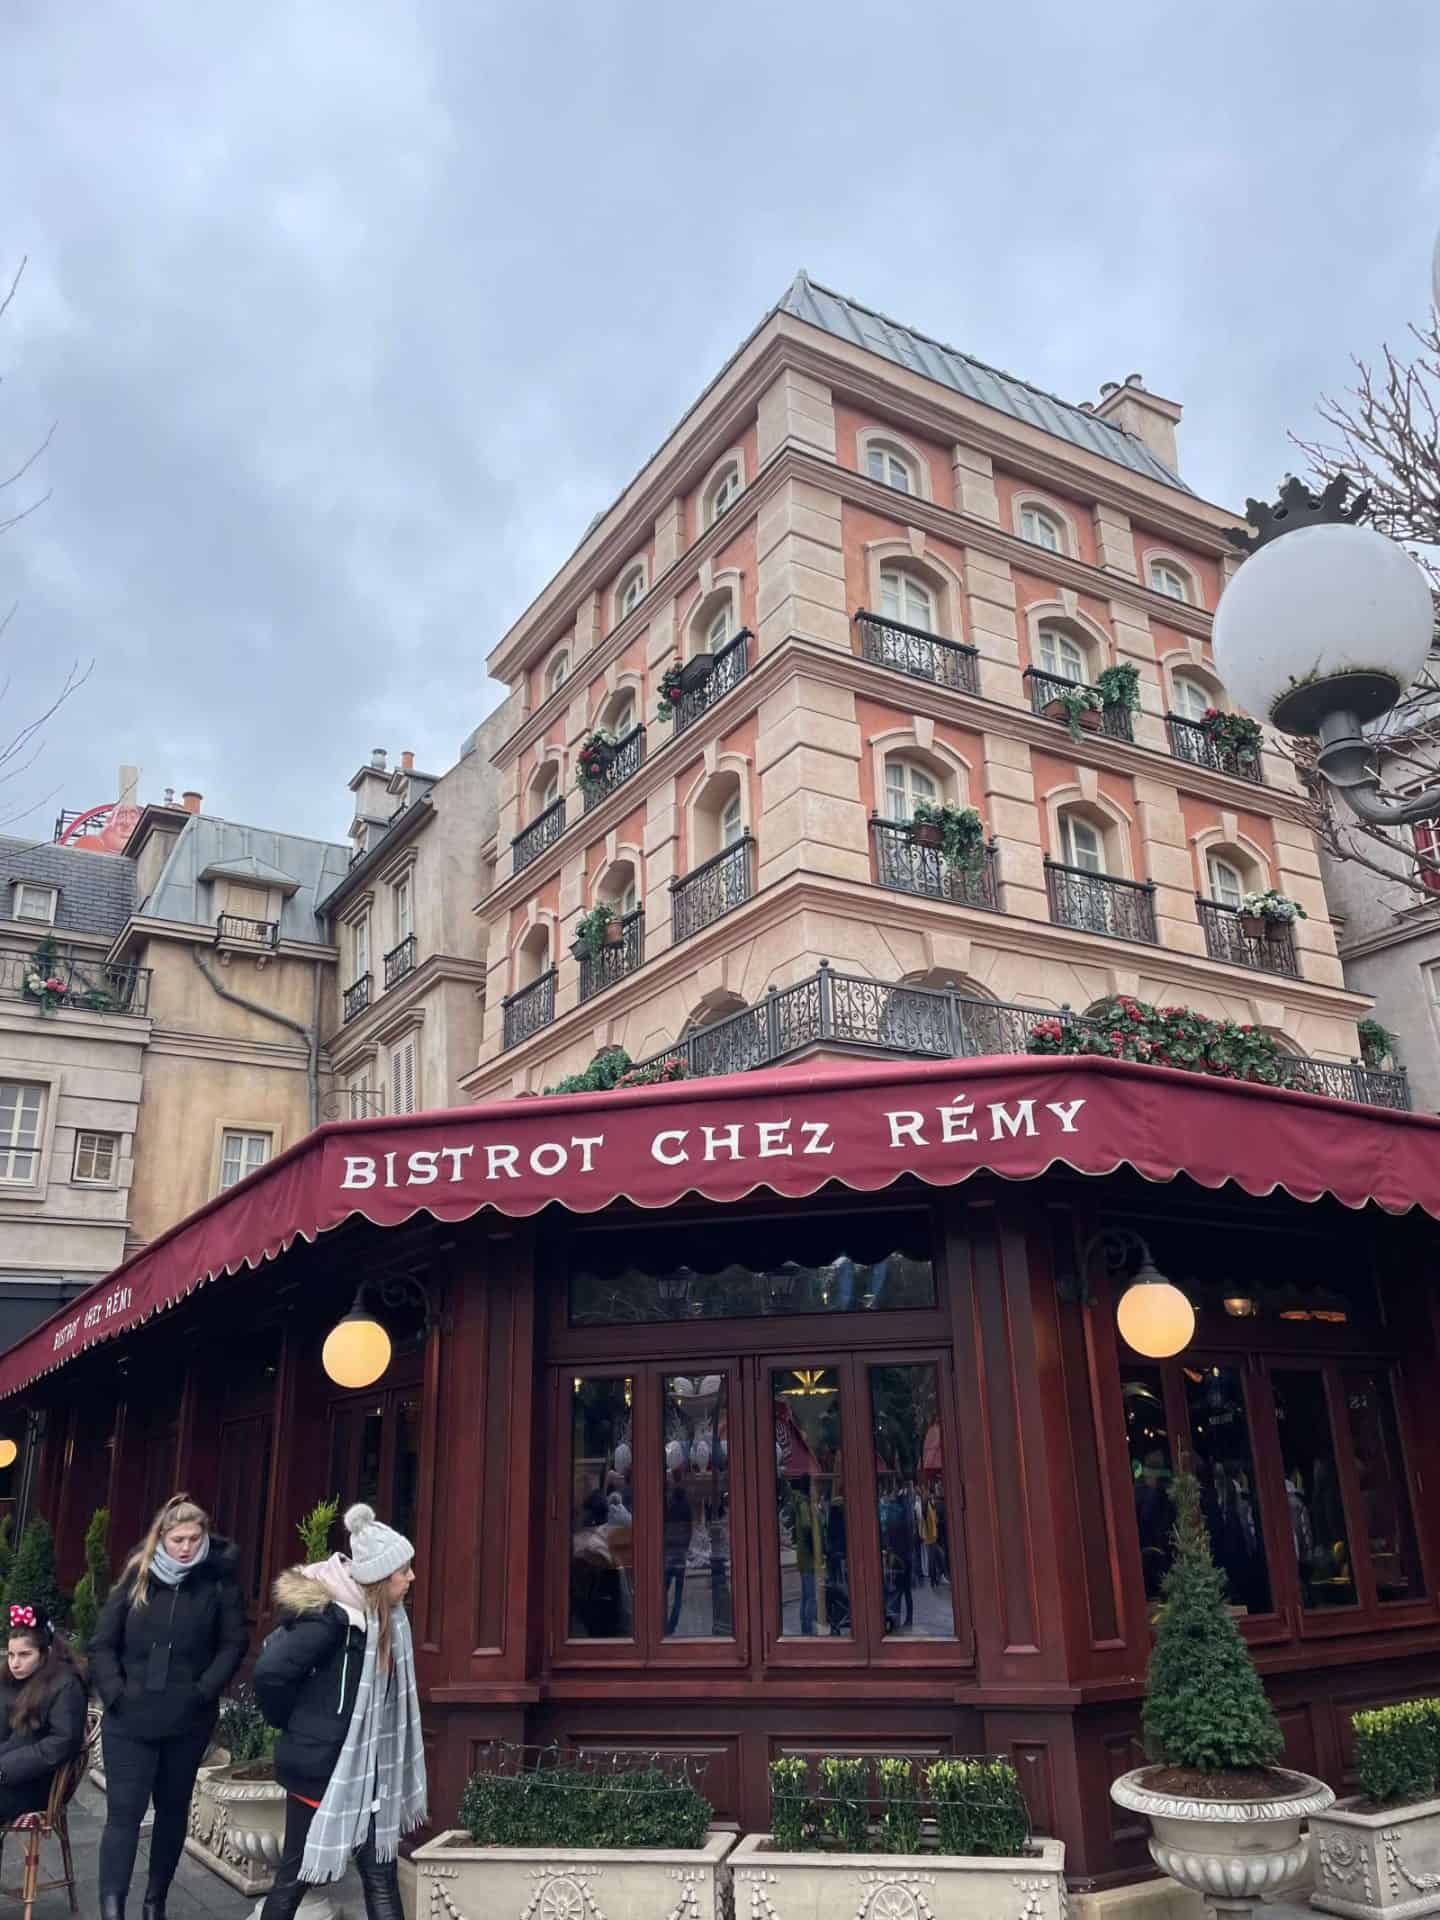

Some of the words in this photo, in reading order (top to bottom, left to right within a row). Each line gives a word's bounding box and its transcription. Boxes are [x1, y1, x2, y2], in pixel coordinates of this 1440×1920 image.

[340, 1134, 604, 1189] BISTROT
[651, 1118, 835, 1165] CHEZ
[884, 1093, 1086, 1148] RÉMY
